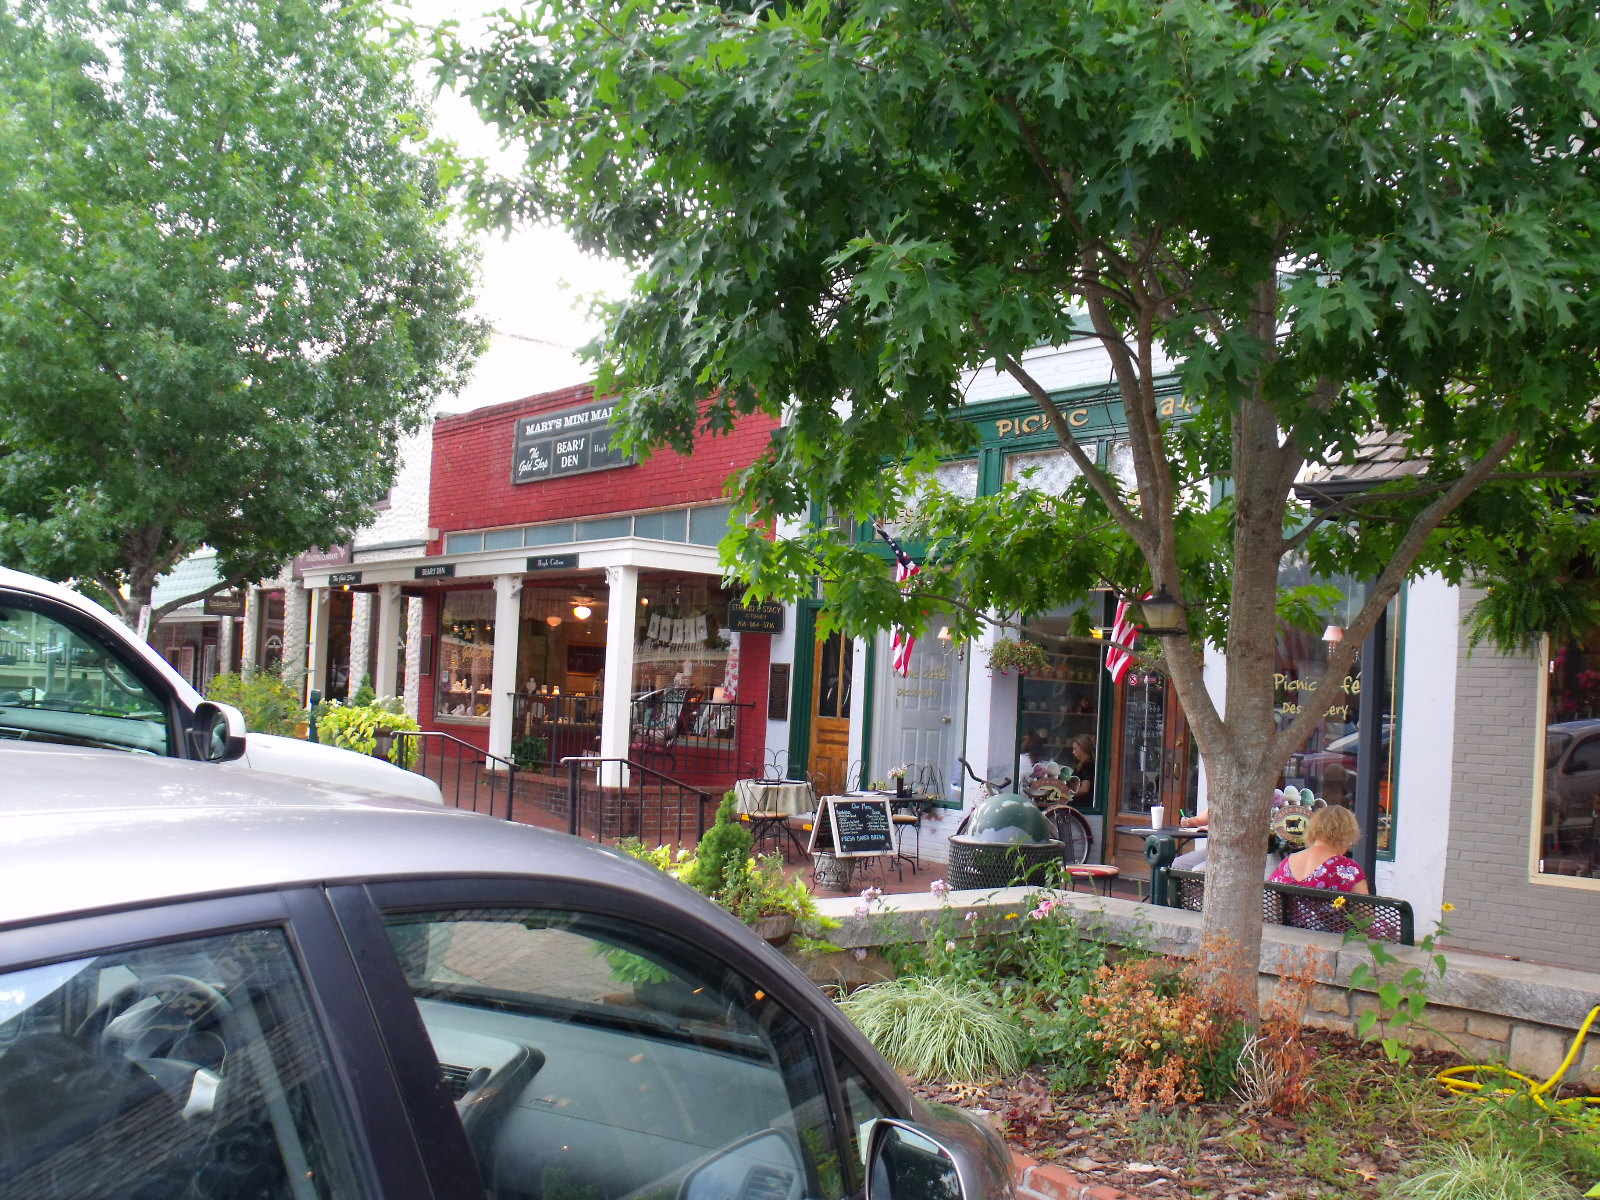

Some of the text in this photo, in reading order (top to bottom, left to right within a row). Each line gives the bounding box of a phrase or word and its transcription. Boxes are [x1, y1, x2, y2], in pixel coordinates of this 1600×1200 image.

[525, 406, 614, 436] MARY'S MINI MA
[529, 447, 540, 460] The
[556, 438, 585, 454] BEAR'S
[518, 457, 549, 476] Gold Shop
[561, 454, 579, 468] DEN
[762, 605, 781, 614] STACY
[1273, 671, 1362, 695] Picnic fé
